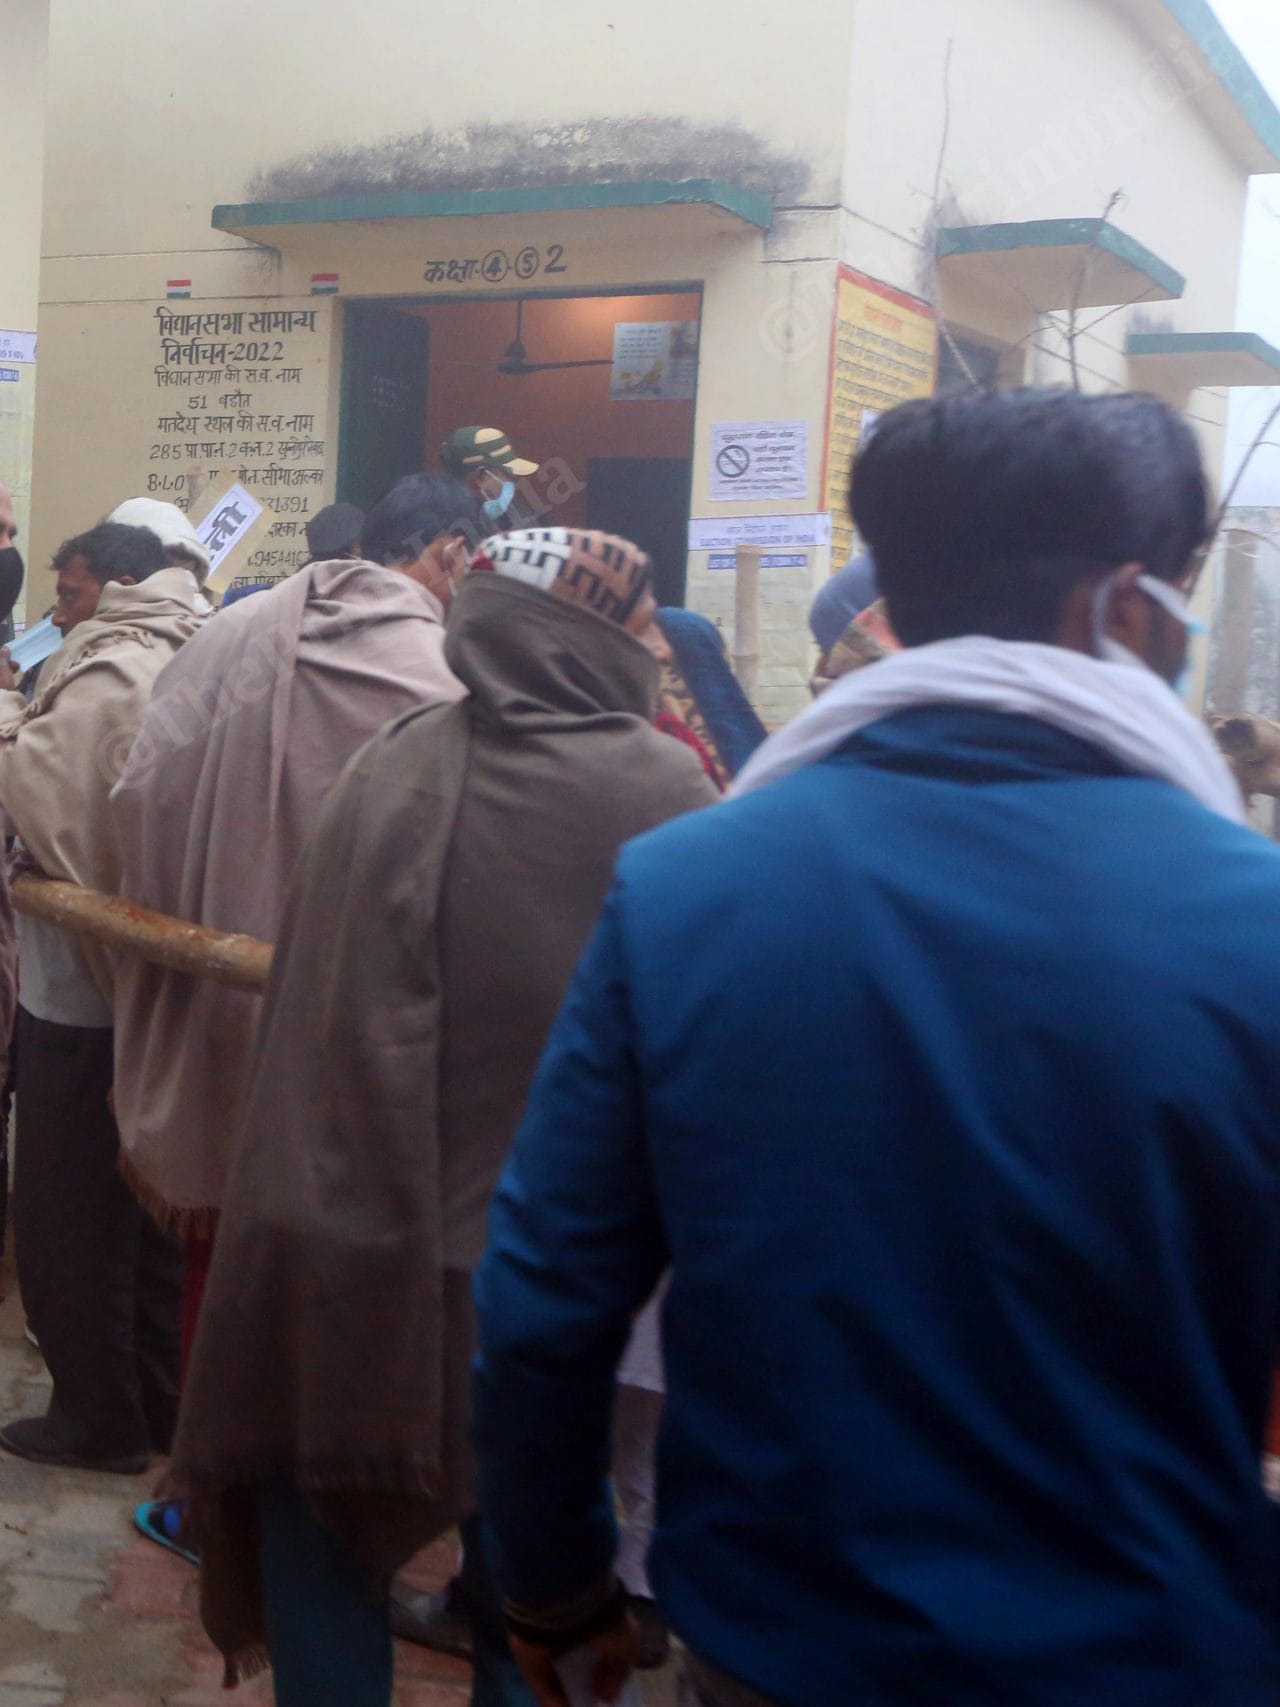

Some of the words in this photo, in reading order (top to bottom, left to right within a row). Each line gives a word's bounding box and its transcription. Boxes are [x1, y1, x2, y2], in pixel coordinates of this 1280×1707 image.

[248, 310, 319, 333] सामान्य
[187, 395, 208, 410] 51
[150, 444, 182, 460] 285
